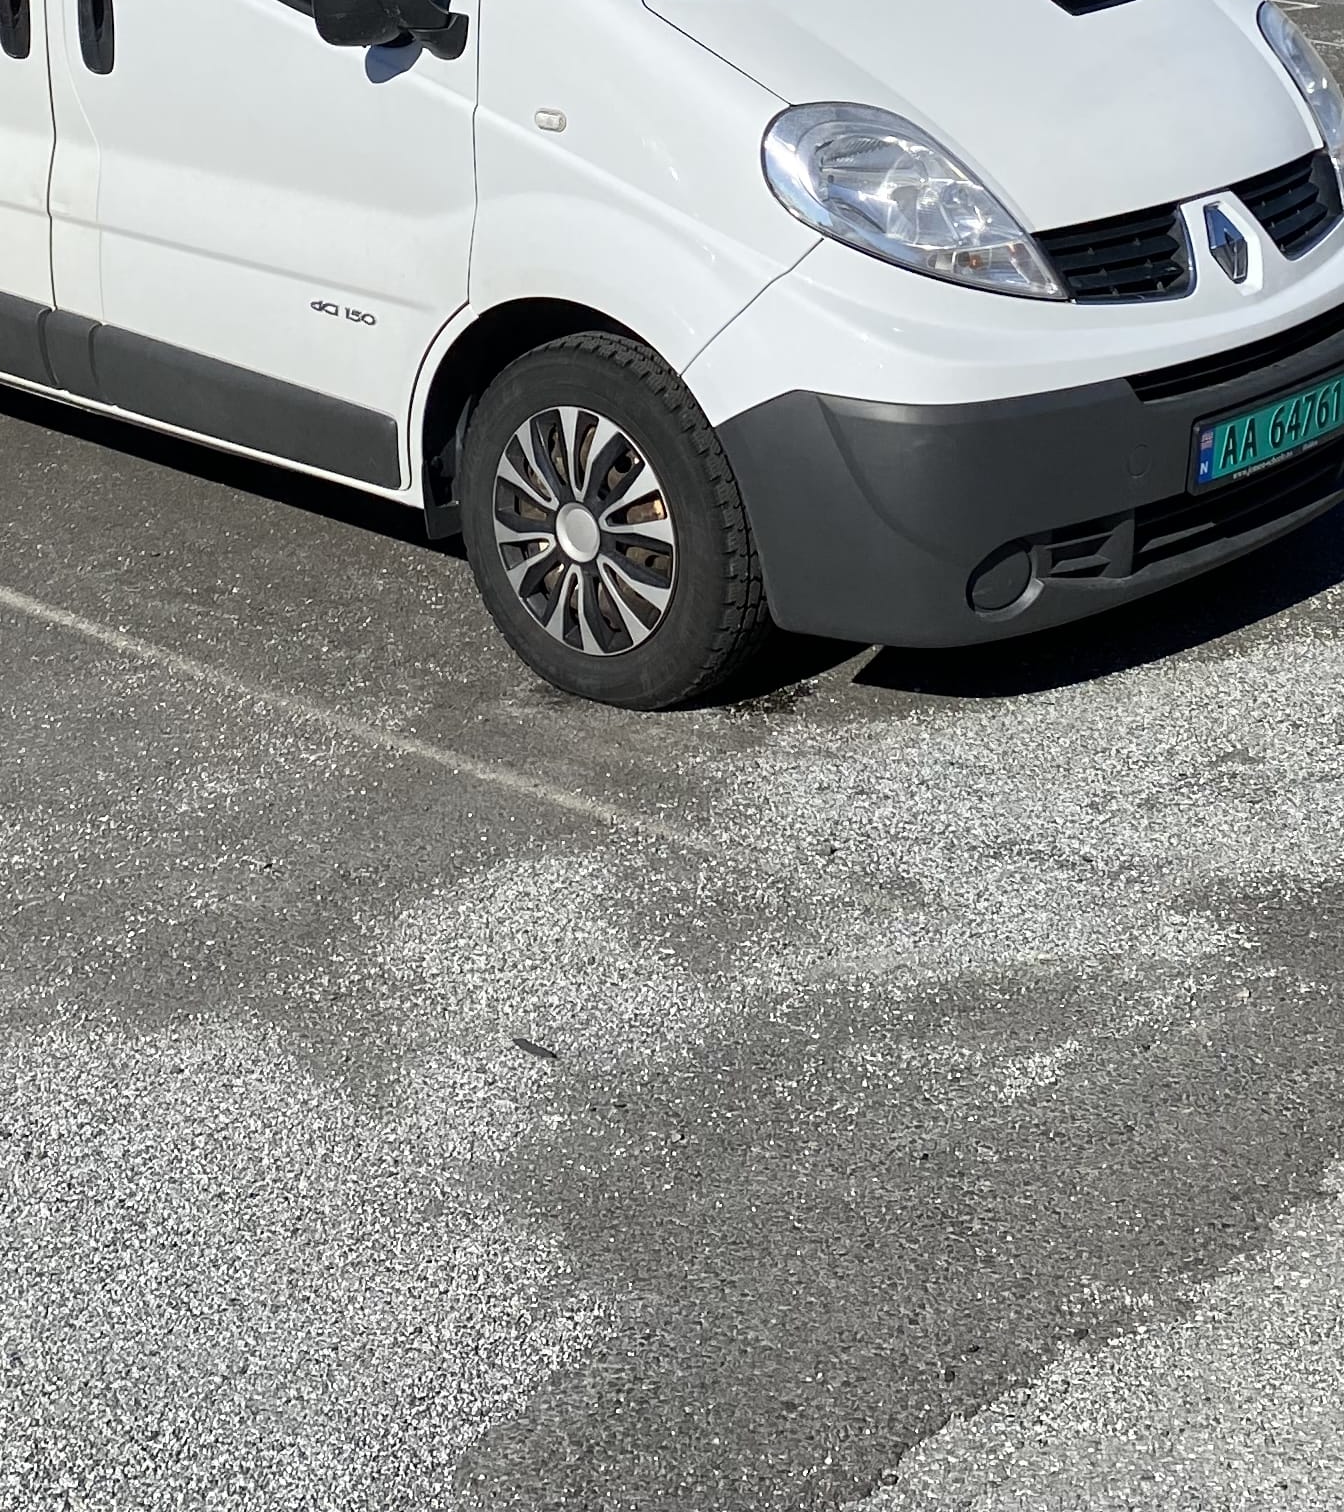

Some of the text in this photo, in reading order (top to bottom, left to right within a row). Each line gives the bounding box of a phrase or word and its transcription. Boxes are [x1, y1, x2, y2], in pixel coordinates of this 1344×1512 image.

[344, 307, 377, 326] 150
[1219, 380, 1342, 469] AA 64761
[1199, 460, 1208, 476] N
